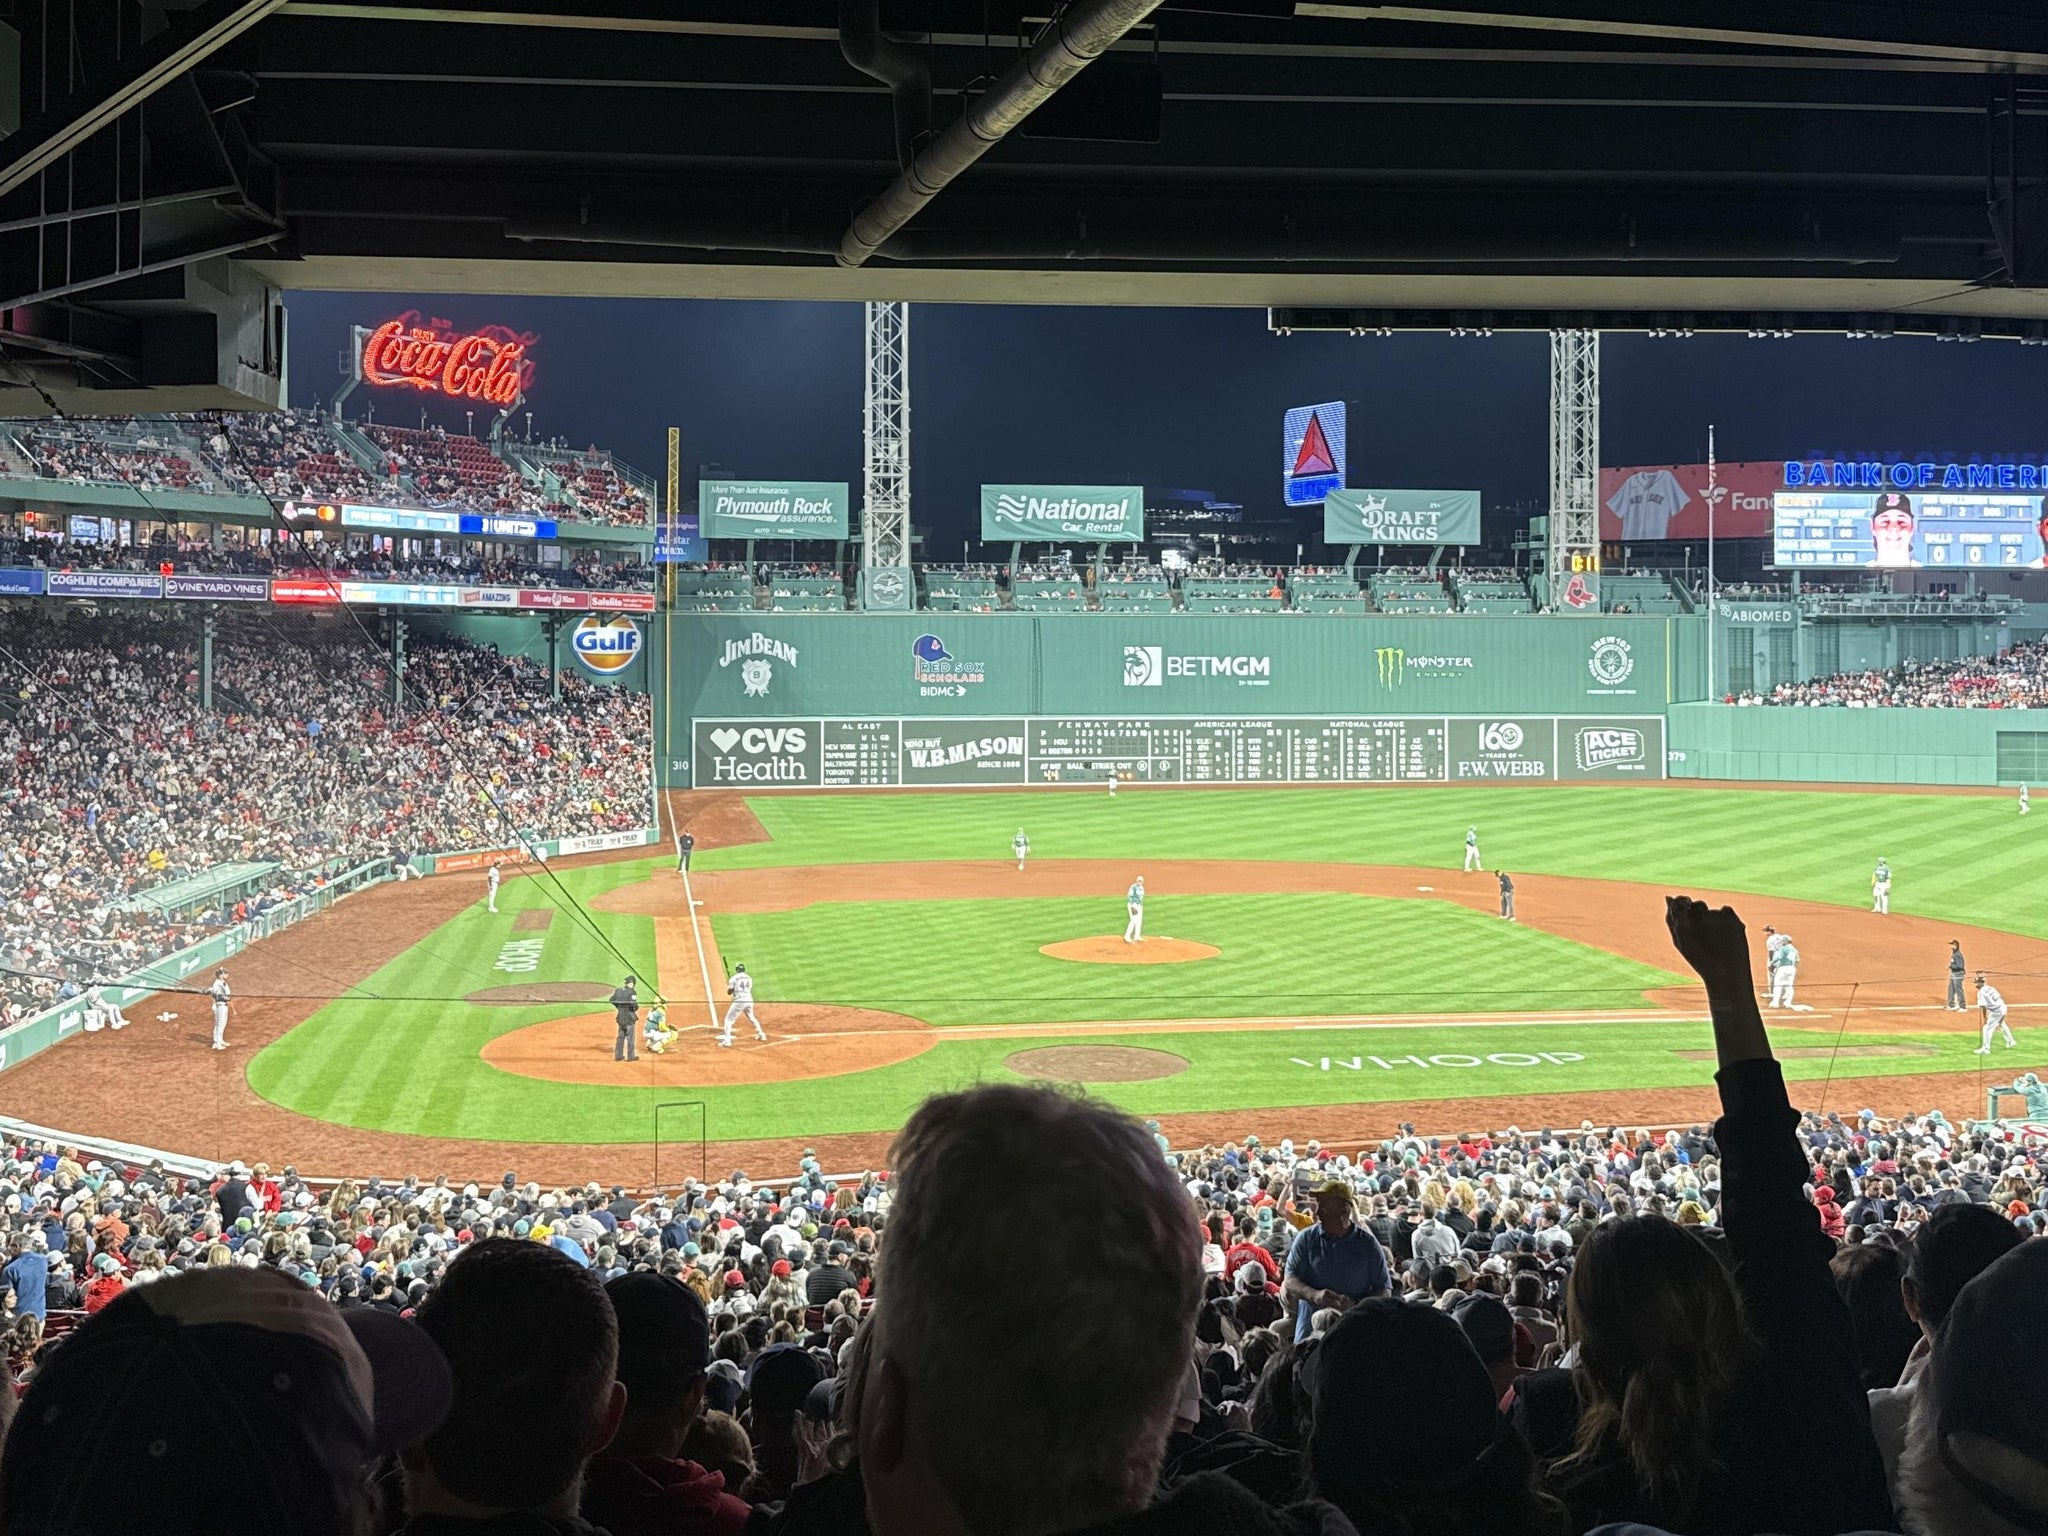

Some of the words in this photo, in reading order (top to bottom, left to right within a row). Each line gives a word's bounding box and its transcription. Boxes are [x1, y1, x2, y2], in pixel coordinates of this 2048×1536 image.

[1784, 461, 1882, 487] BANK
[1890, 463, 1936, 488] OF
[711, 485, 729, 494] More
[730, 486, 745, 494] Than
[745, 487, 758, 495] Just
[715, 496, 792, 516] Plymouth
[793, 498, 833, 515] Rock
[1026, 498, 1128, 521] National
[780, 514, 833, 524] assurance
[1361, 508, 1441, 528] DRAFT
[1062, 522, 1082, 532] Car
[1086, 522, 1123, 533] Rental
[1372, 526, 1438, 541] KINGS
[1933, 545, 1946, 562] 0
[1969, 546, 1982, 563] 0
[2005, 547, 2018, 564] 2
[50, 574, 97, 586] COGHLIN
[99, 576, 160, 589] COMPANIES
[178, 582, 231, 593] VINEYARD
[234, 583, 265, 594] VINES
[1731, 610, 1792, 622] ABIOMED
[575, 630, 638, 651] Gulf
[720, 639, 751, 668] JIM
[751, 632, 799, 668] BEAM
[921, 662, 950, 673] RED
[954, 662, 985, 673] SOX
[1167, 656, 1270, 676] BETMGM
[1406, 655, 1474, 668] MONSTER
[920, 673, 985, 683] SCHOLARS
[920, 687, 955, 697] BIDMC
[741, 727, 807, 753] CVS
[1478, 722, 1524, 751] 160
[1589, 730, 1638, 749] ACE
[1590, 746, 1638, 762] TICKET
[1667, 751, 1686, 761] 379
[672, 761, 689, 771] 310
[713, 756, 807, 781] Health
[825, 768, 855, 776] TORONTO
[1458, 761, 1489, 776] F.W.
[1491, 761, 1545, 776] WEBB
[1043, 769, 1060, 781] 44
[739, 980, 750, 990] 44
[1288, 1052, 1586, 1071] WHOOP
